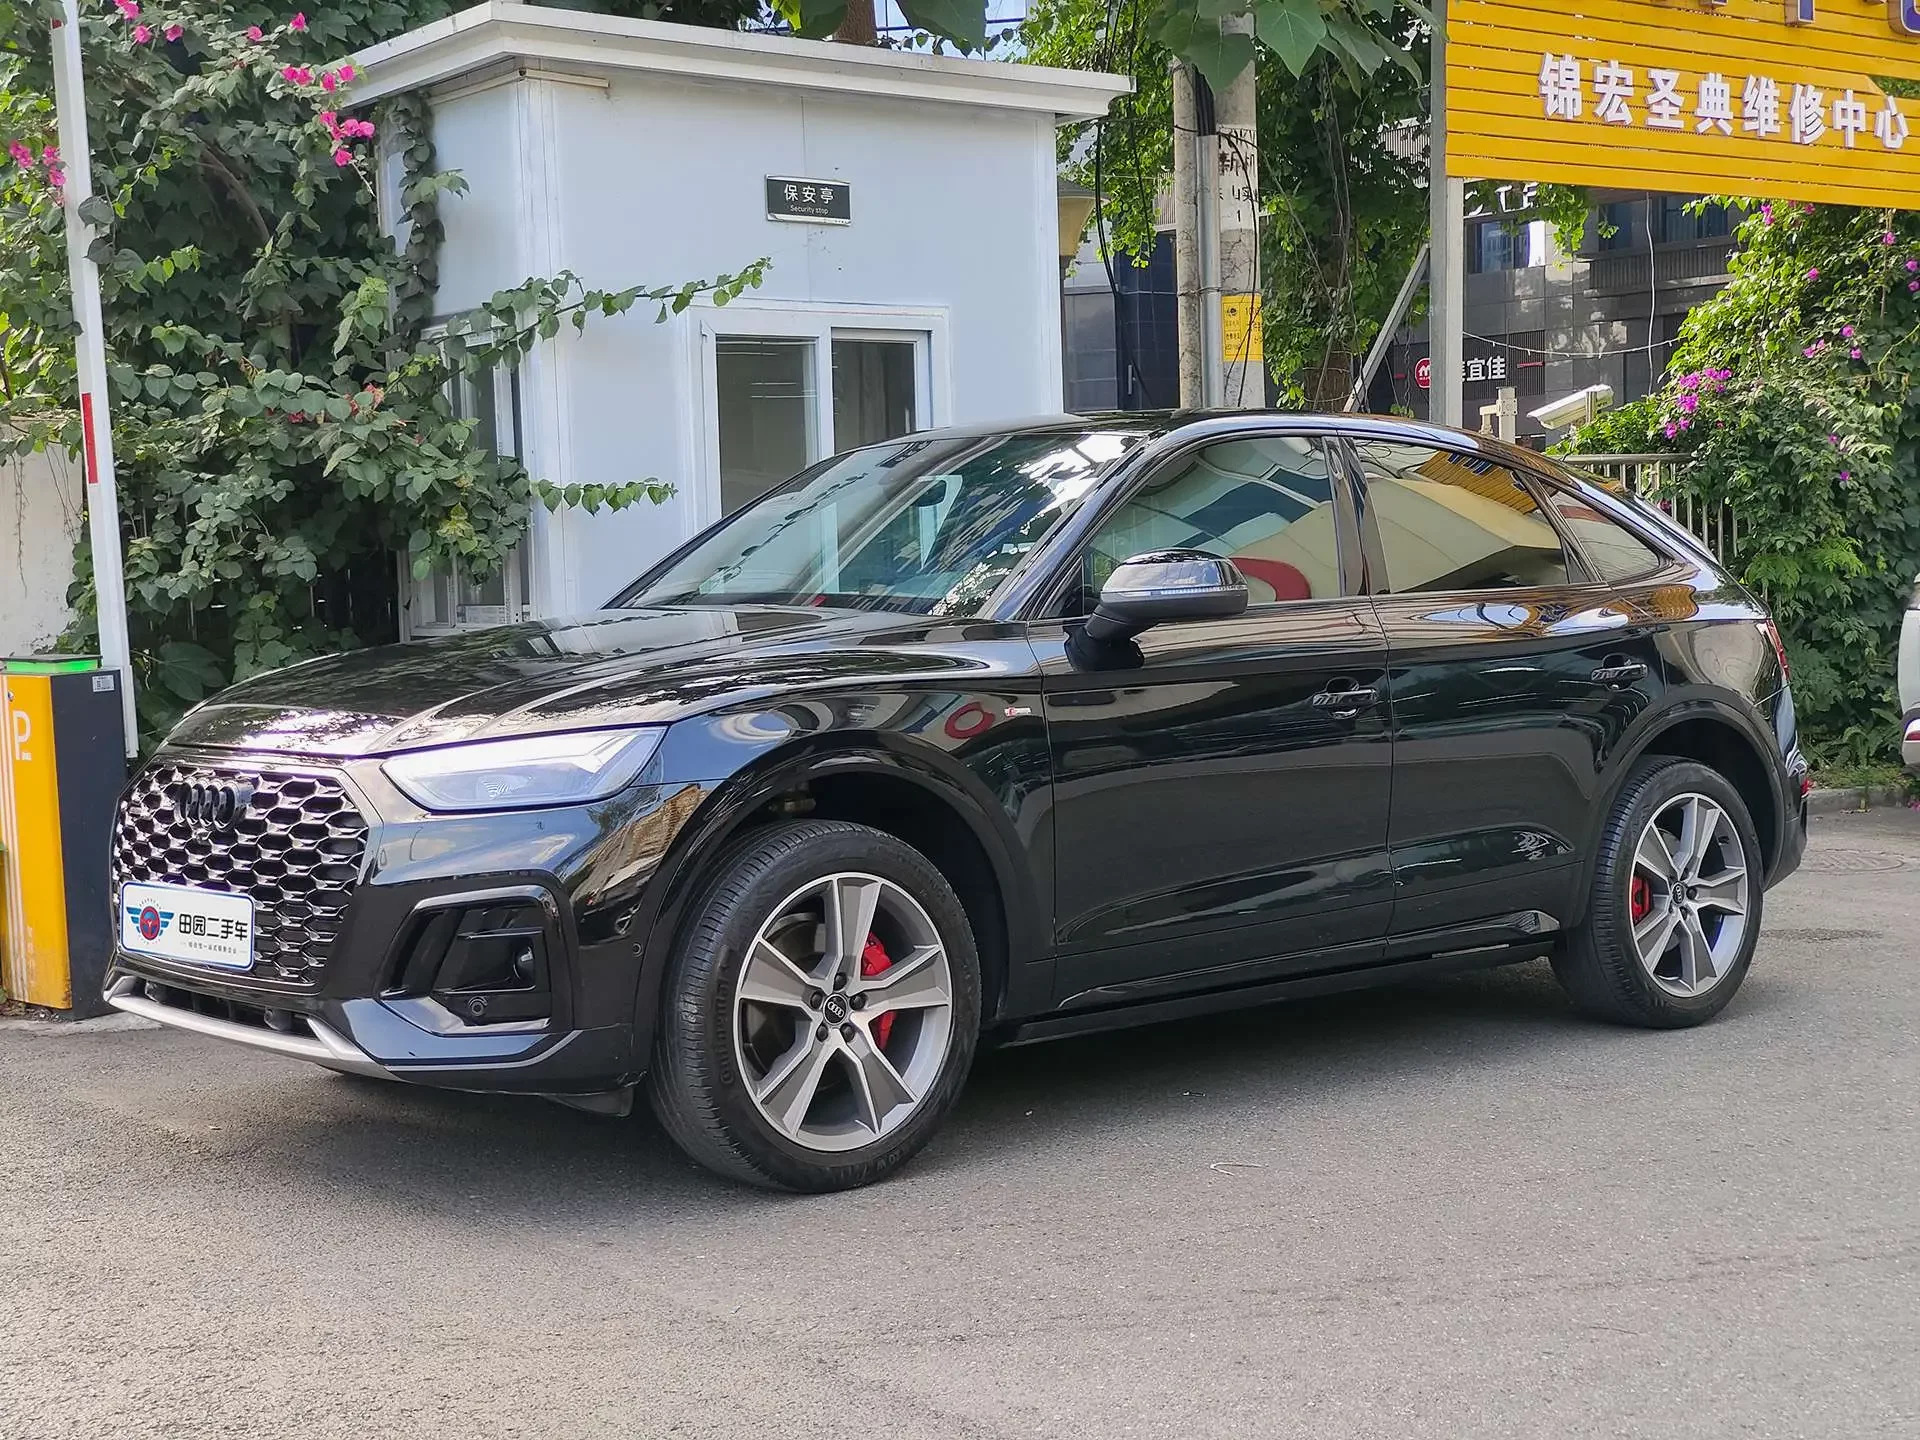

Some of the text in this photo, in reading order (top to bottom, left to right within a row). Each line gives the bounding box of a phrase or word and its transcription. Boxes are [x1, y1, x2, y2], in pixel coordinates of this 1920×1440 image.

[1539, 52, 1909, 149] 锦宏圣典维修中心
[784, 183, 834, 204] 保安亭
[790, 204, 814, 215] Security
[1462, 355, 1506, 383] 宜佳
[179, 913, 248, 941] 田园二手车
